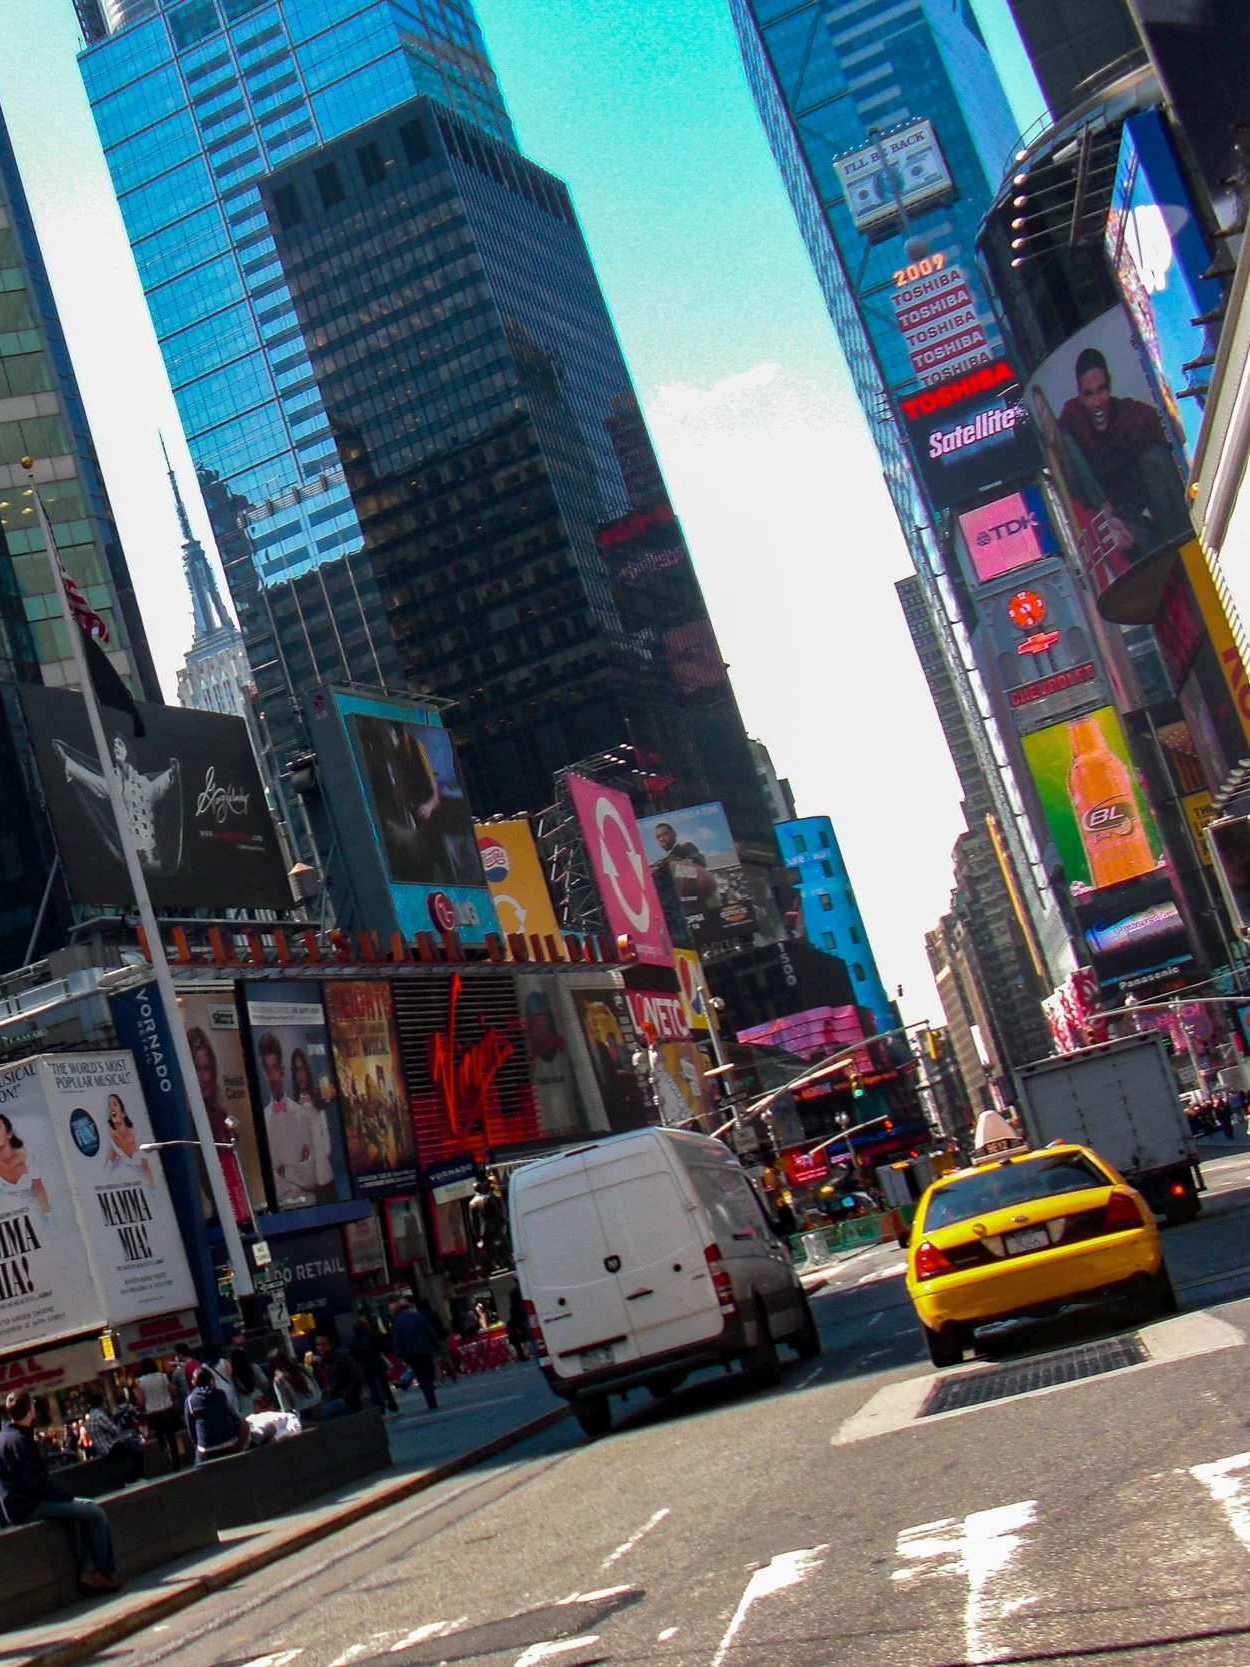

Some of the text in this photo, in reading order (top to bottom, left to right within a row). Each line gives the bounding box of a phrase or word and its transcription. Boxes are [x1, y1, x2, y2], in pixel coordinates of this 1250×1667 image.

[891, 131, 925, 154] BACK
[892, 253, 947, 287] 2009
[892, 269, 962, 306] TOSHIBA
[898, 290, 970, 327] TOSHIBA
[906, 309, 976, 347] TOSHIBA
[912, 330, 984, 368] TOSHIBA
[920, 350, 992, 389] TOSHIBA
[900, 361, 1016, 420] TOSHIBA
[929, 407, 1018, 459] Satellite
[988, 511, 1040, 541] TDK
[1009, 663, 1094, 707] CHEVROLET
[778, 942, 798, 986] 1500
[1119, 966, 1180, 990] Panasonic
[135, 988, 172, 1092] VORNADO
[55, 1075, 94, 1089] POPULAR
[105, 1059, 128, 1072] MOST
[429, 1164, 473, 1181] VORNADO
[98, 1188, 153, 1227] MAMMA
[117, 1224, 153, 1262] MIA!
[296, 1257, 345, 1280] RETAIL
